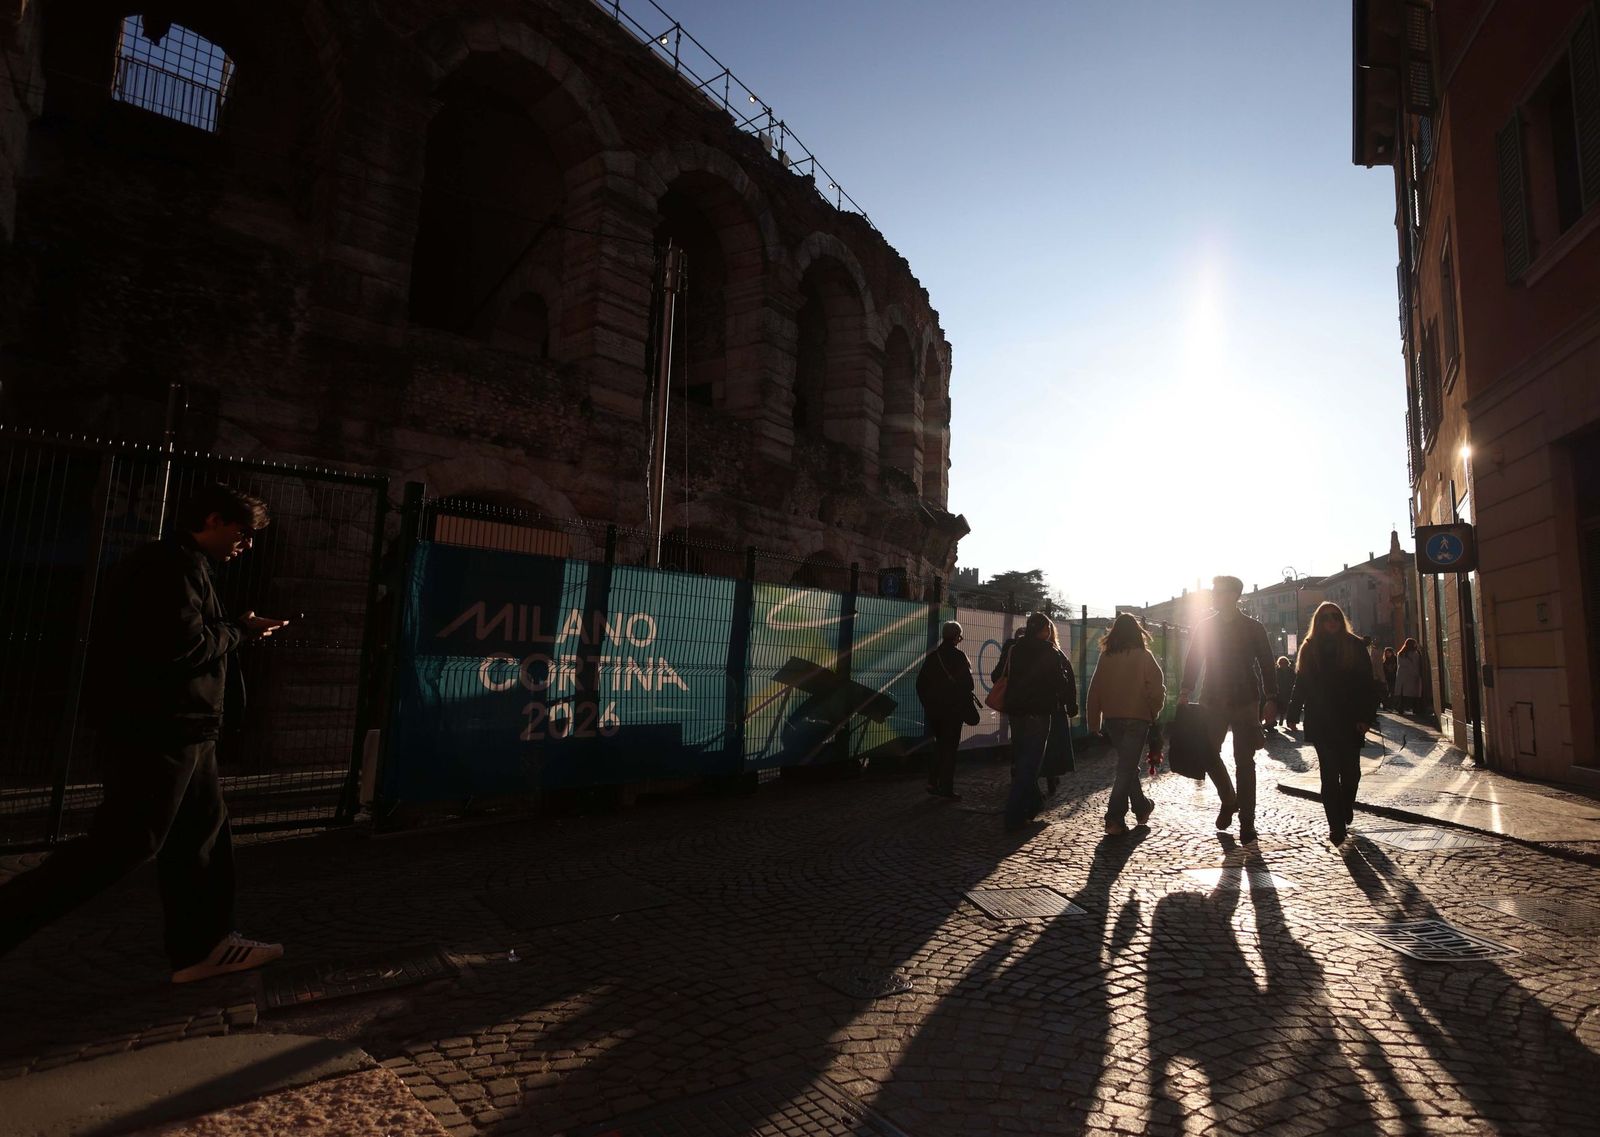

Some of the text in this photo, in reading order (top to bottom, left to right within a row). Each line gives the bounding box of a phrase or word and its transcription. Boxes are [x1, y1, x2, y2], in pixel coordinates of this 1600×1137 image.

[436, 601, 657, 647] MILANO
[478, 653, 690, 692] CORTINA
[519, 702, 621, 742] 2026
